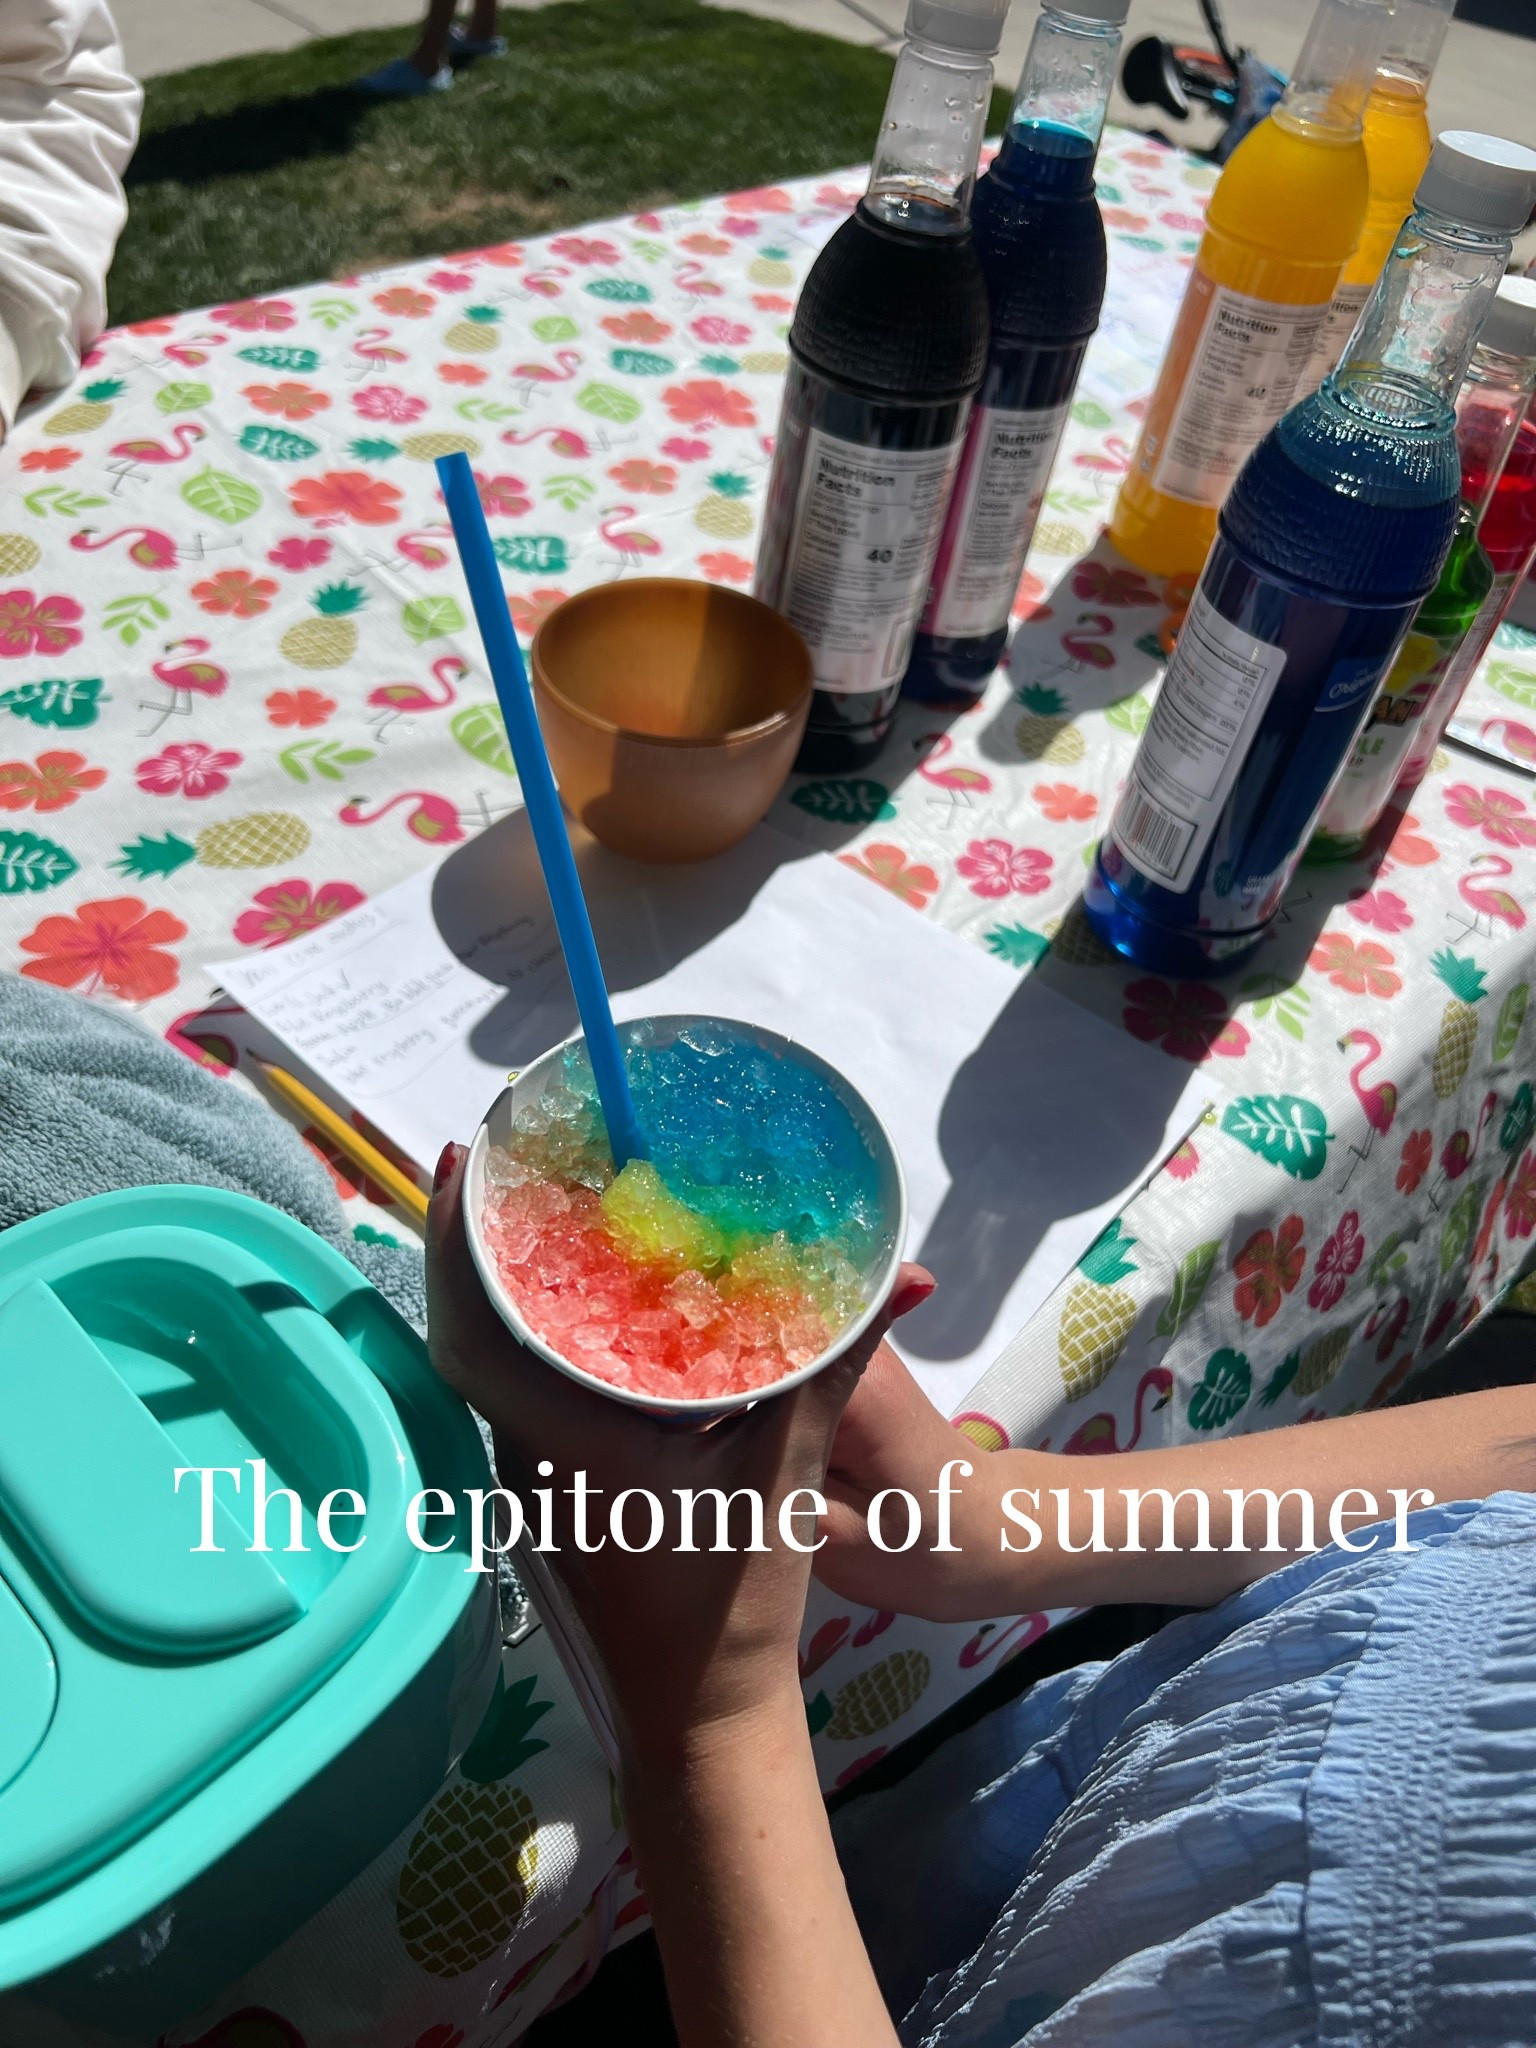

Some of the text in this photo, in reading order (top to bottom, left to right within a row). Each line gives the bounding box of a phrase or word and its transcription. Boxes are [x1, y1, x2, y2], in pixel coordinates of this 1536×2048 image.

[815, 471, 862, 497] Facts
[819, 457, 896, 487] Nutrition
[866, 548, 893, 564] 40
